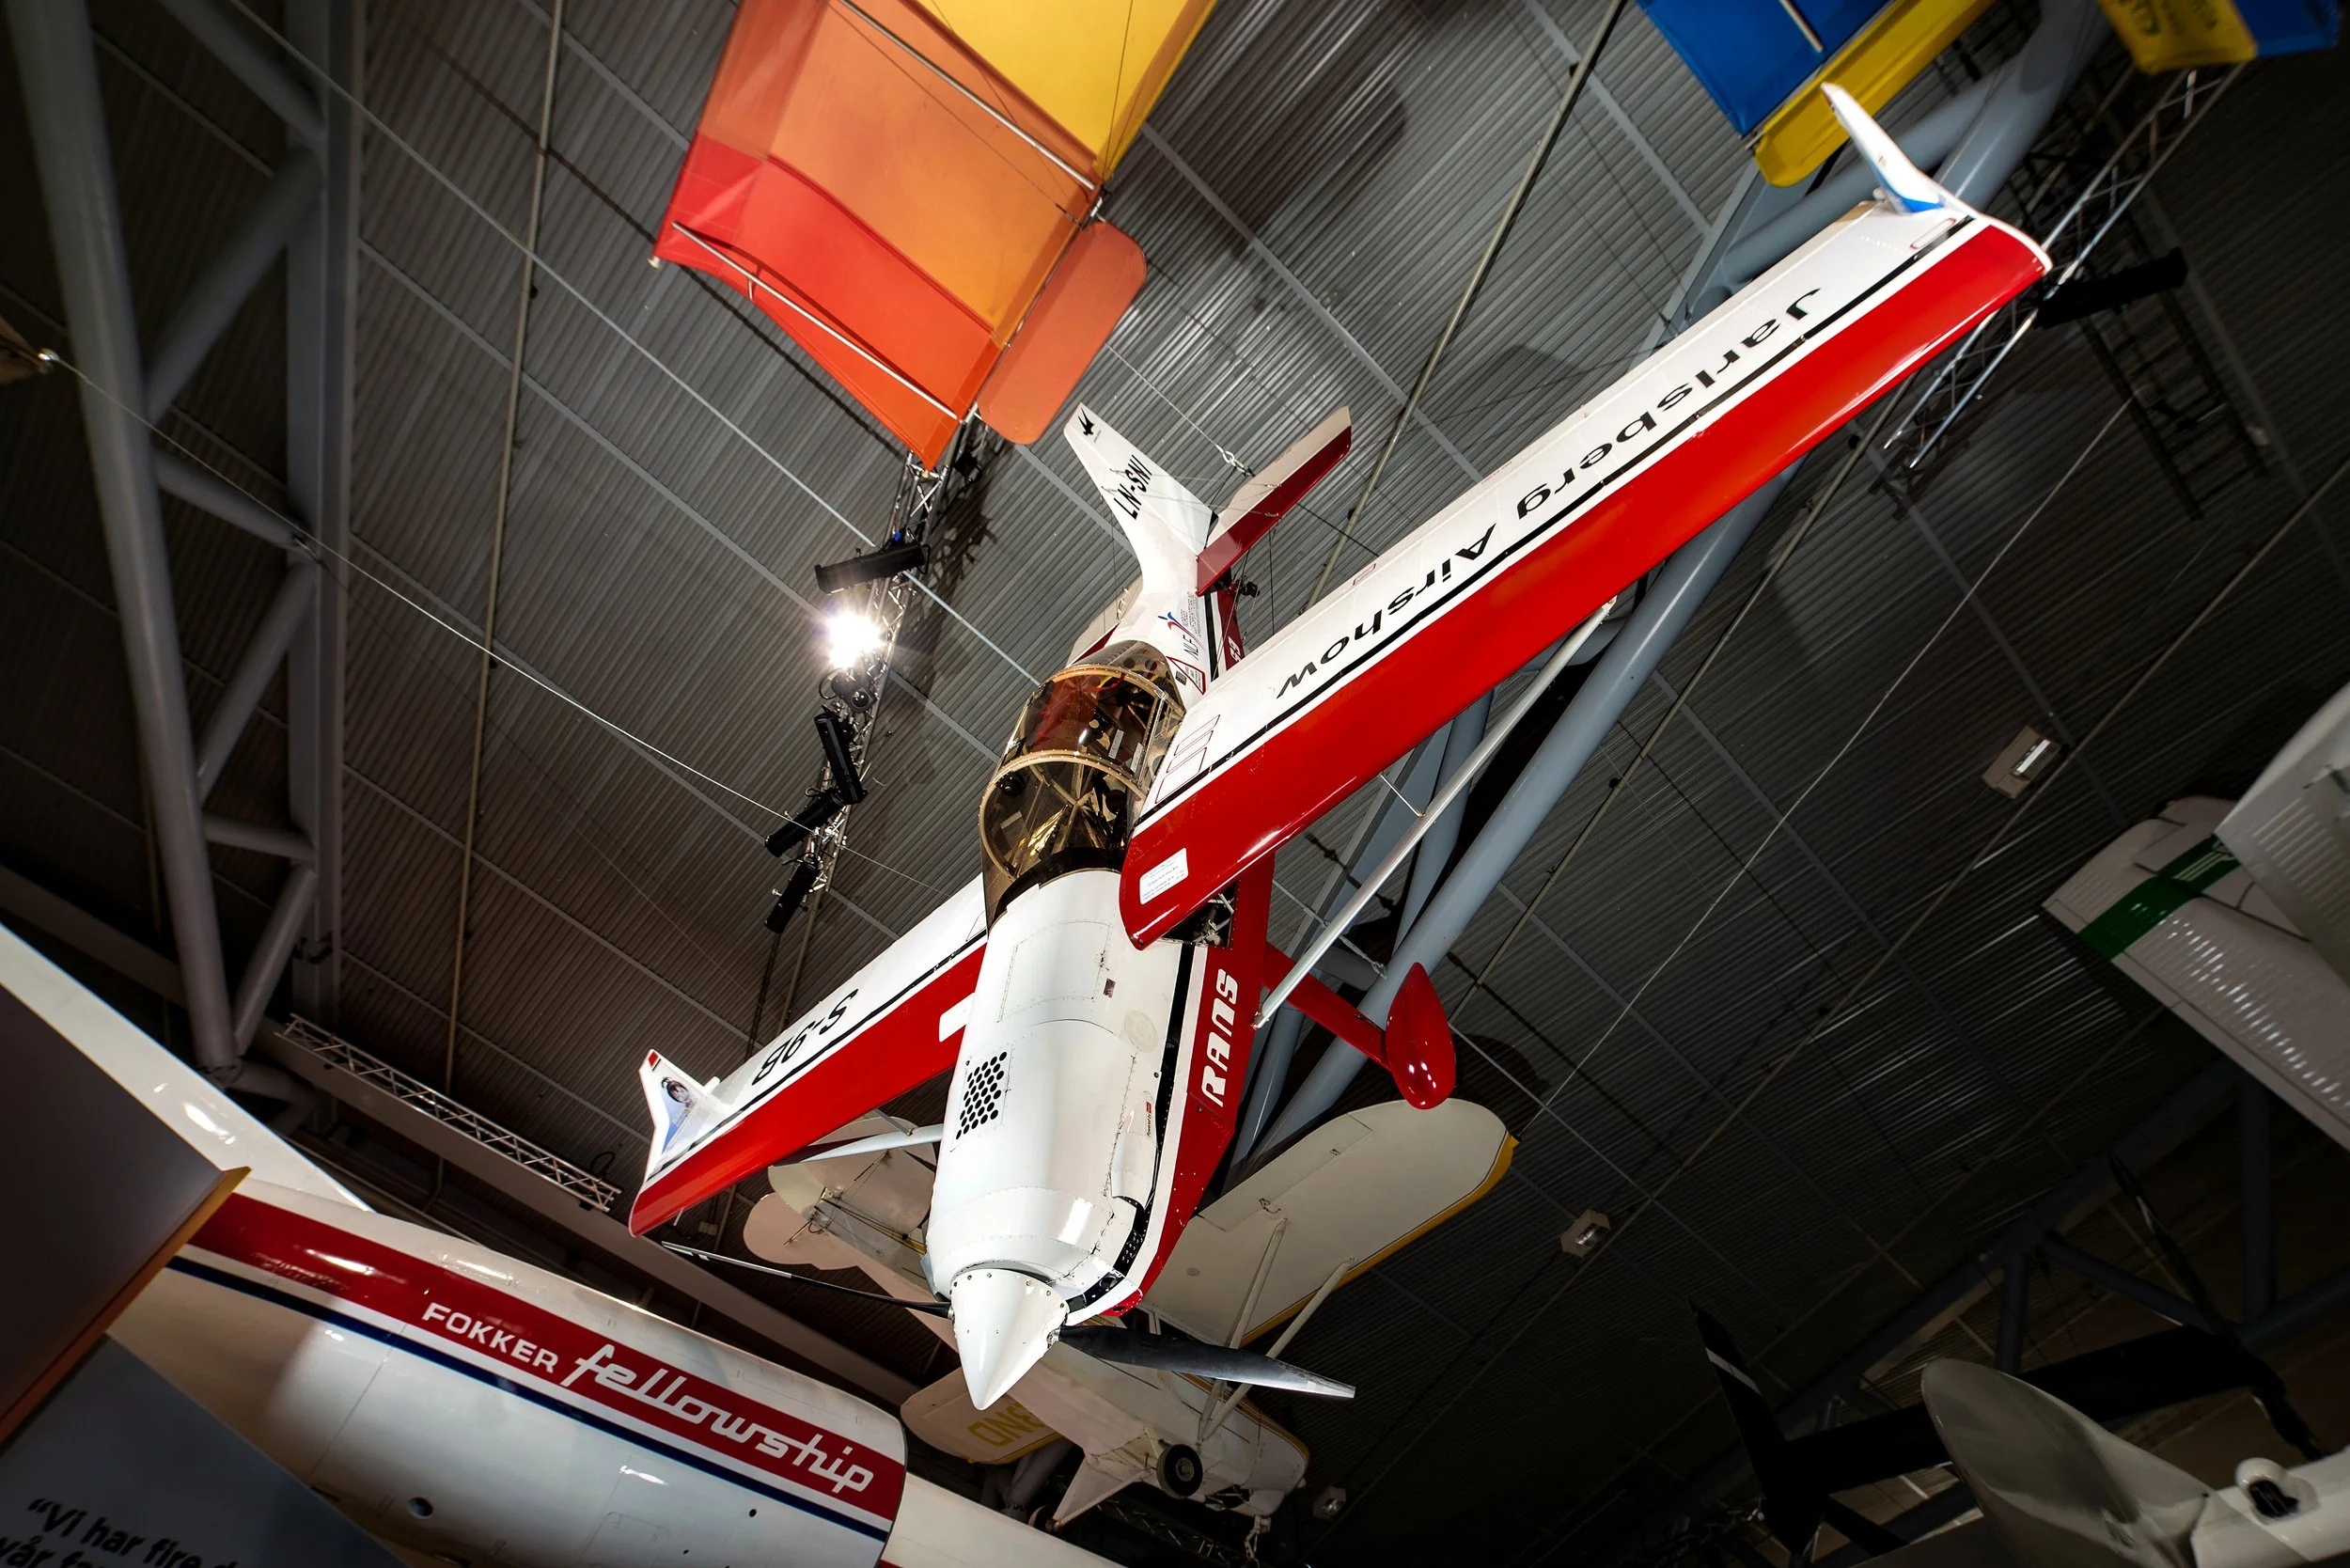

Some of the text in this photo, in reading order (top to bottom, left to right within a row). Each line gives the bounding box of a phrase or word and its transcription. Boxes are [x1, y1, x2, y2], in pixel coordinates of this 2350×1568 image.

[1113, 454, 1152, 520] LN-SNI
[1277, 288, 1821, 699] Jarlsberg Airshow
[1201, 968, 1238, 1107] RANS
[421, 1301, 874, 1494] FOKKER fellowship
[79, 1516, 145, 1557] har
[143, 1538, 203, 1568] fire
